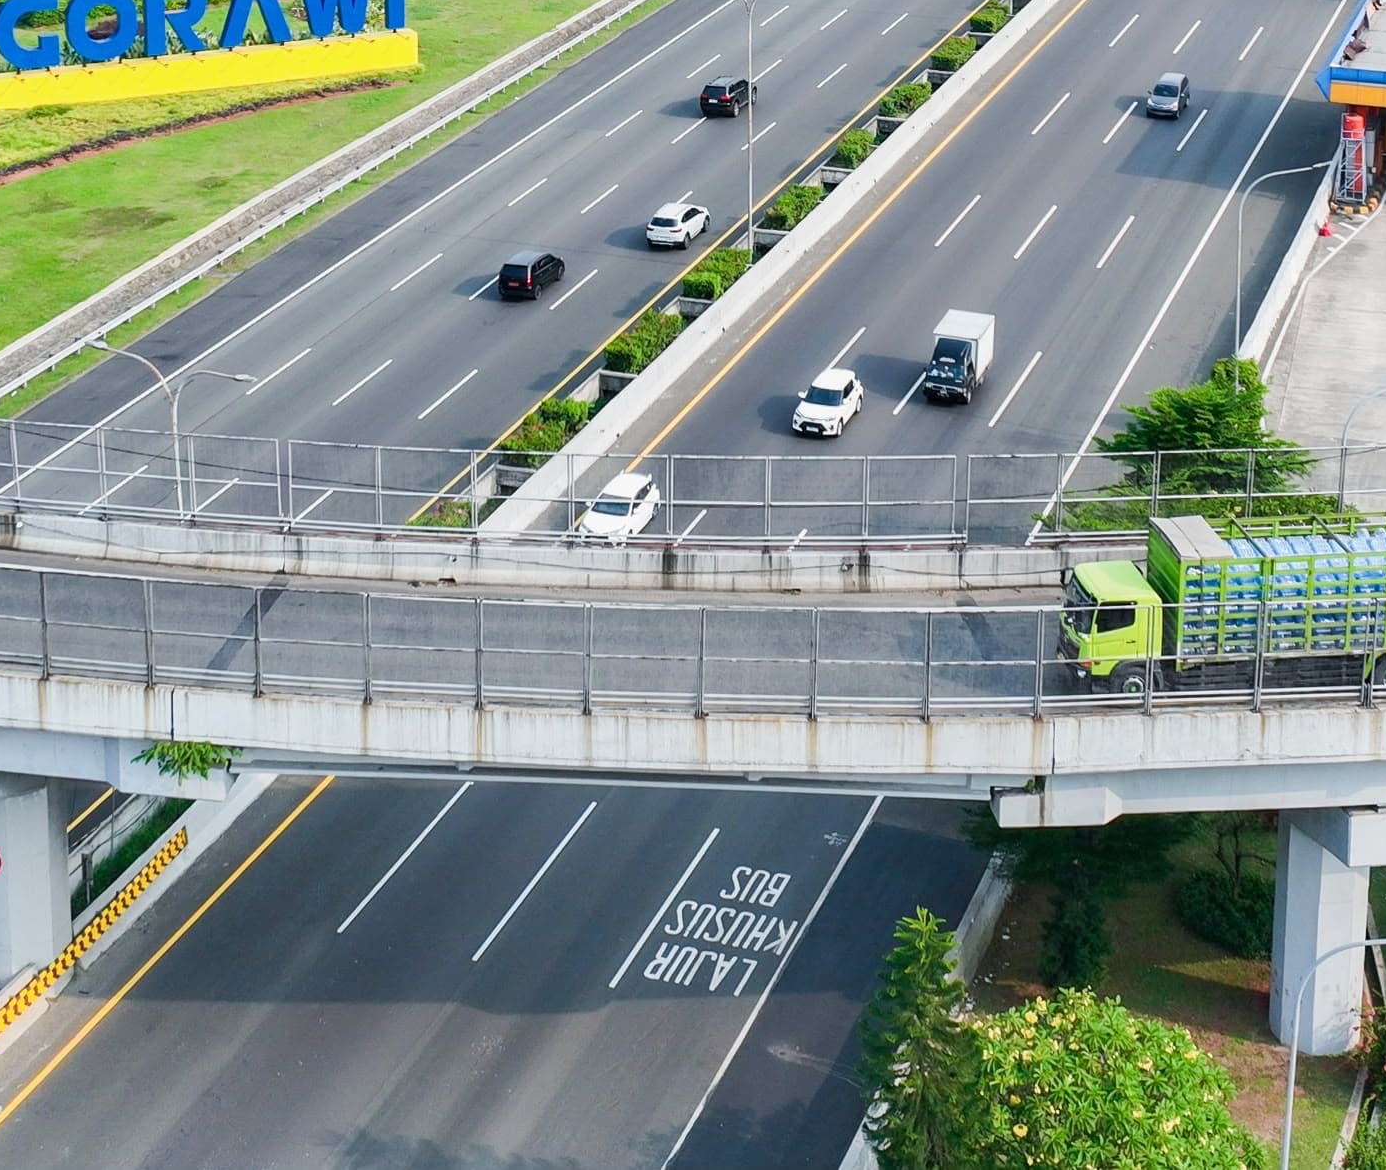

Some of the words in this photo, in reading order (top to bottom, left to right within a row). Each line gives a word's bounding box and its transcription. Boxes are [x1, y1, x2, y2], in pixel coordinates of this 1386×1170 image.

[719, 865, 791, 907] BUS
[664, 900, 798, 956] KHUSUS
[643, 942, 758, 997] LAJUR
